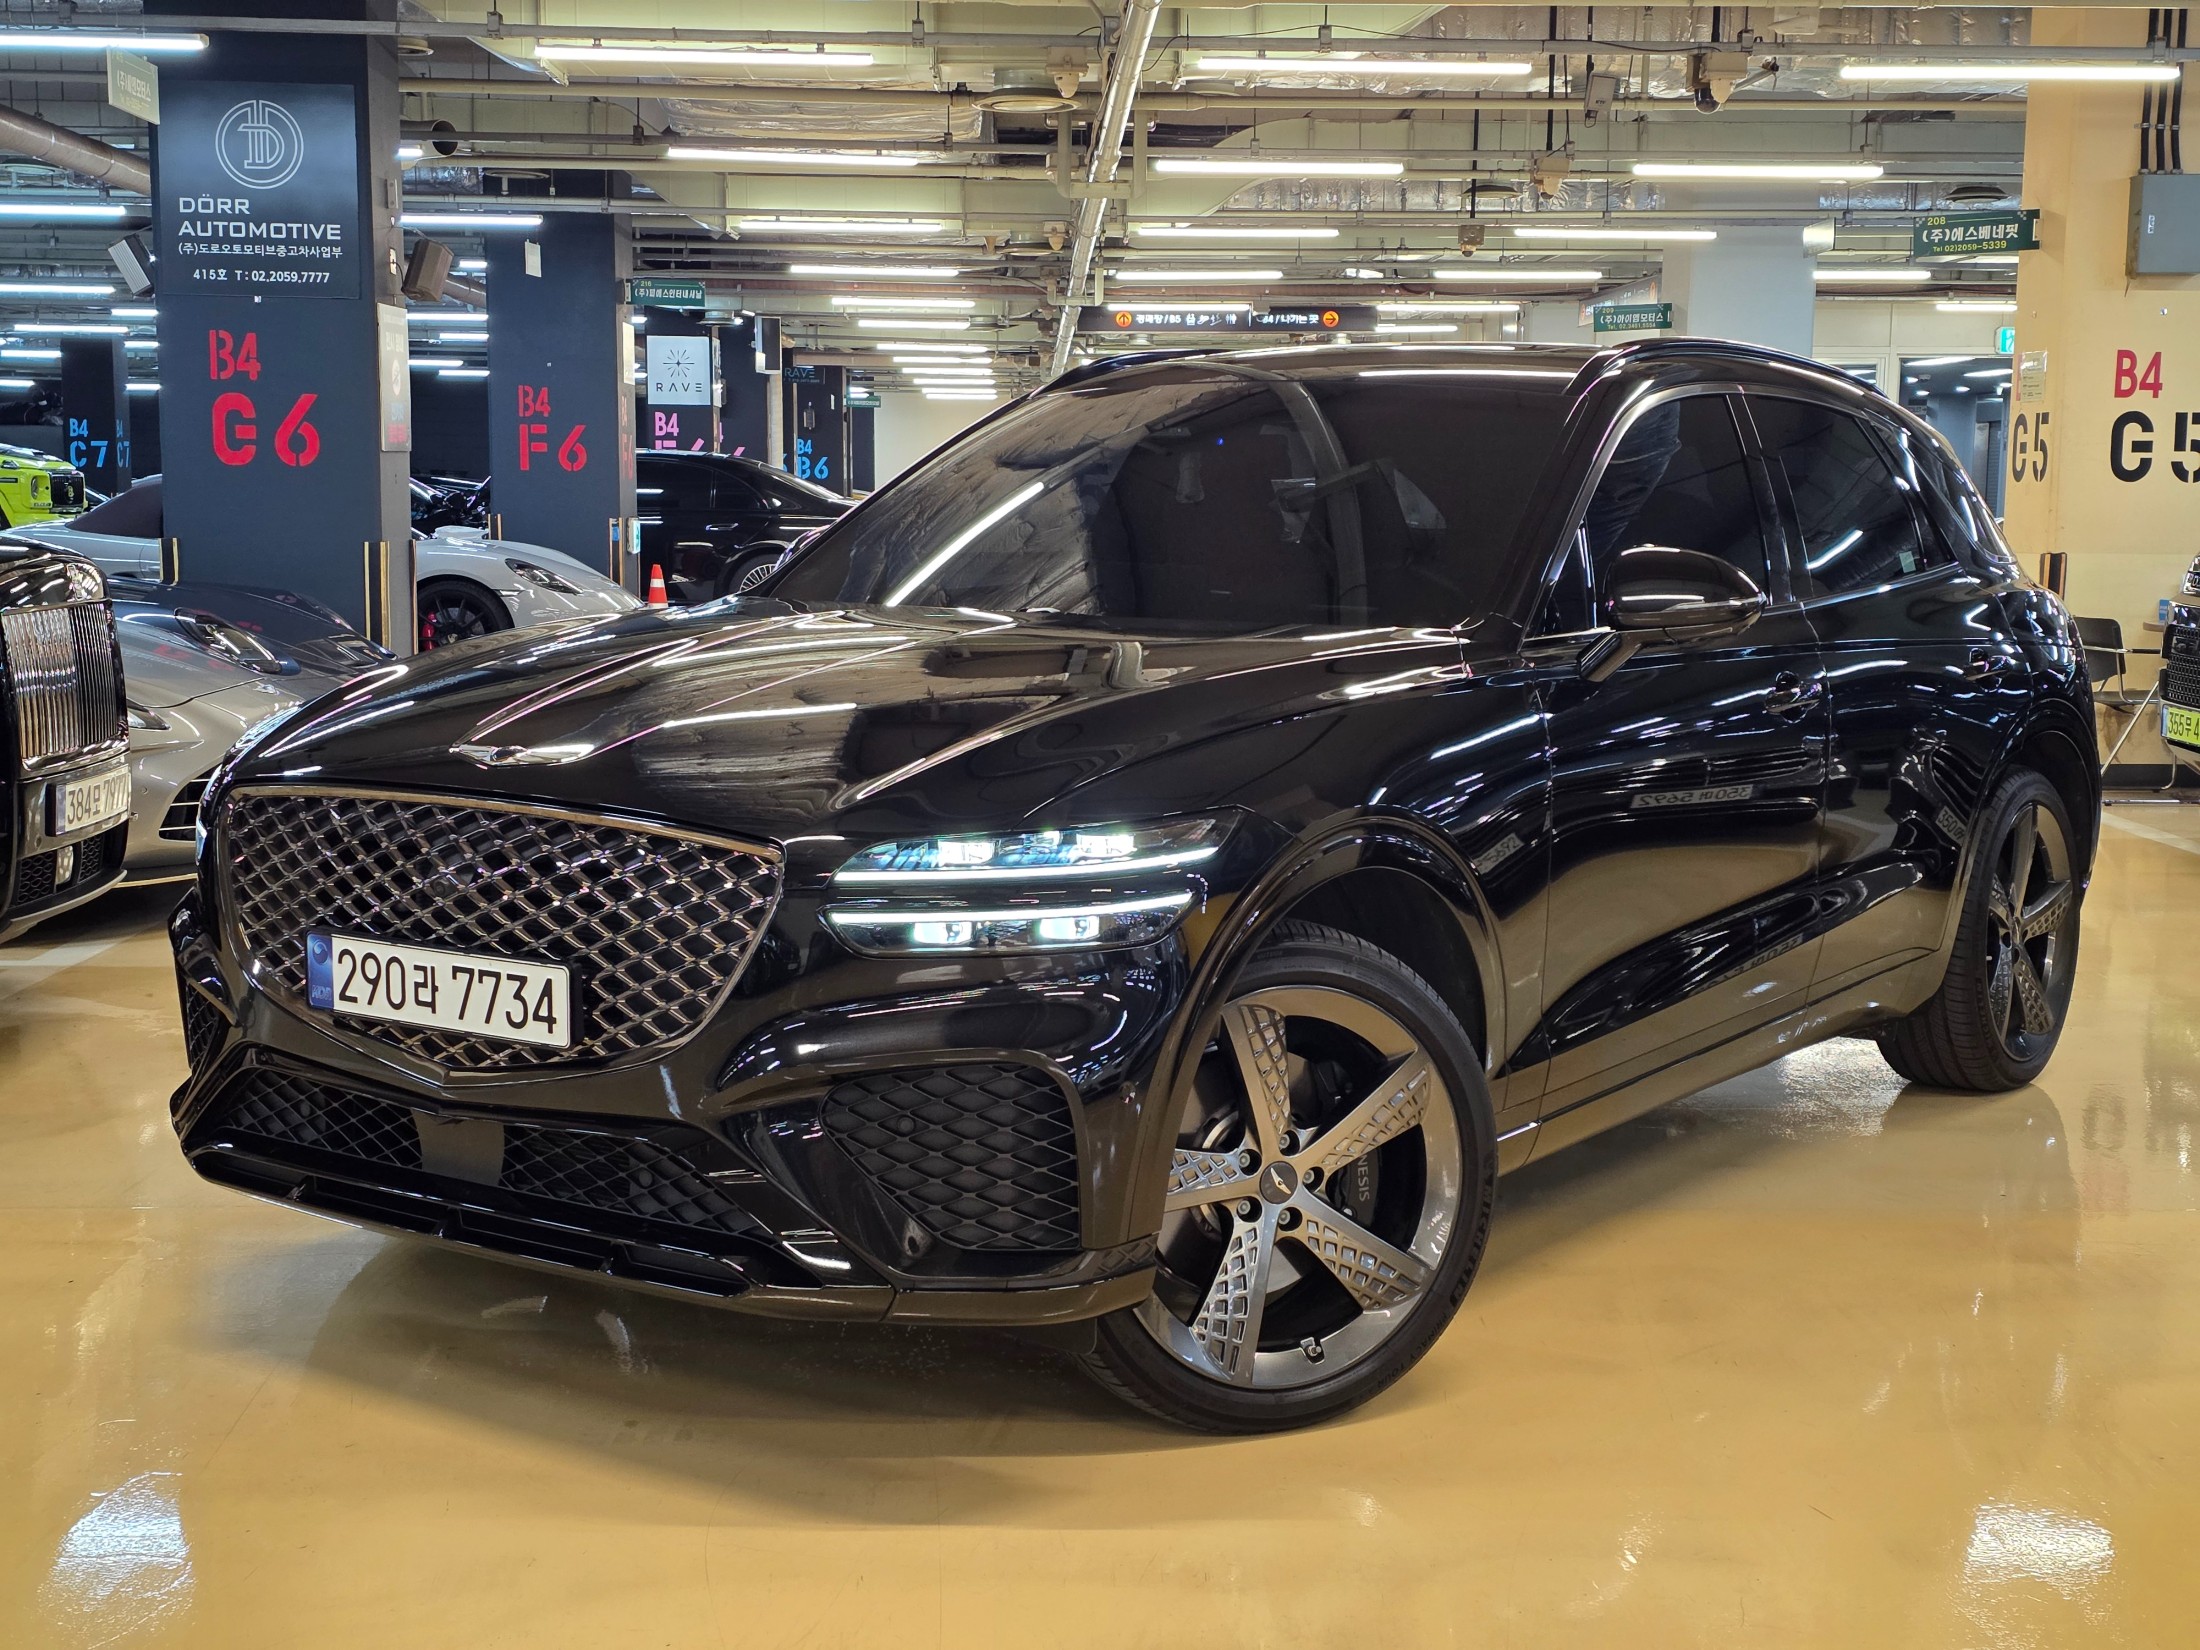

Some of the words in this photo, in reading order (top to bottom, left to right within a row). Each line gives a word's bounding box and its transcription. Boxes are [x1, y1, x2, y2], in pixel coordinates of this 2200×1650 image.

[179, 194, 250, 215] DÖRR
[179, 221, 341, 240] AUTOMOTIVE
[1928, 217, 1946, 225] 208
[1923, 224, 2018, 242] (주)에스베네핏
[1945, 240, 2007, 252] 02)2059-5339
[193, 269, 228, 281] 415호
[209, 330, 261, 380] B4
[2114, 350, 2163, 398] B4
[656, 383, 702, 392] RAVE
[518, 385, 551, 417] B4
[69, 418, 88, 437] B4
[655, 412, 679, 436] B4
[338, 949, 438, 1014] 290라
[452, 966, 557, 1034] 7734
